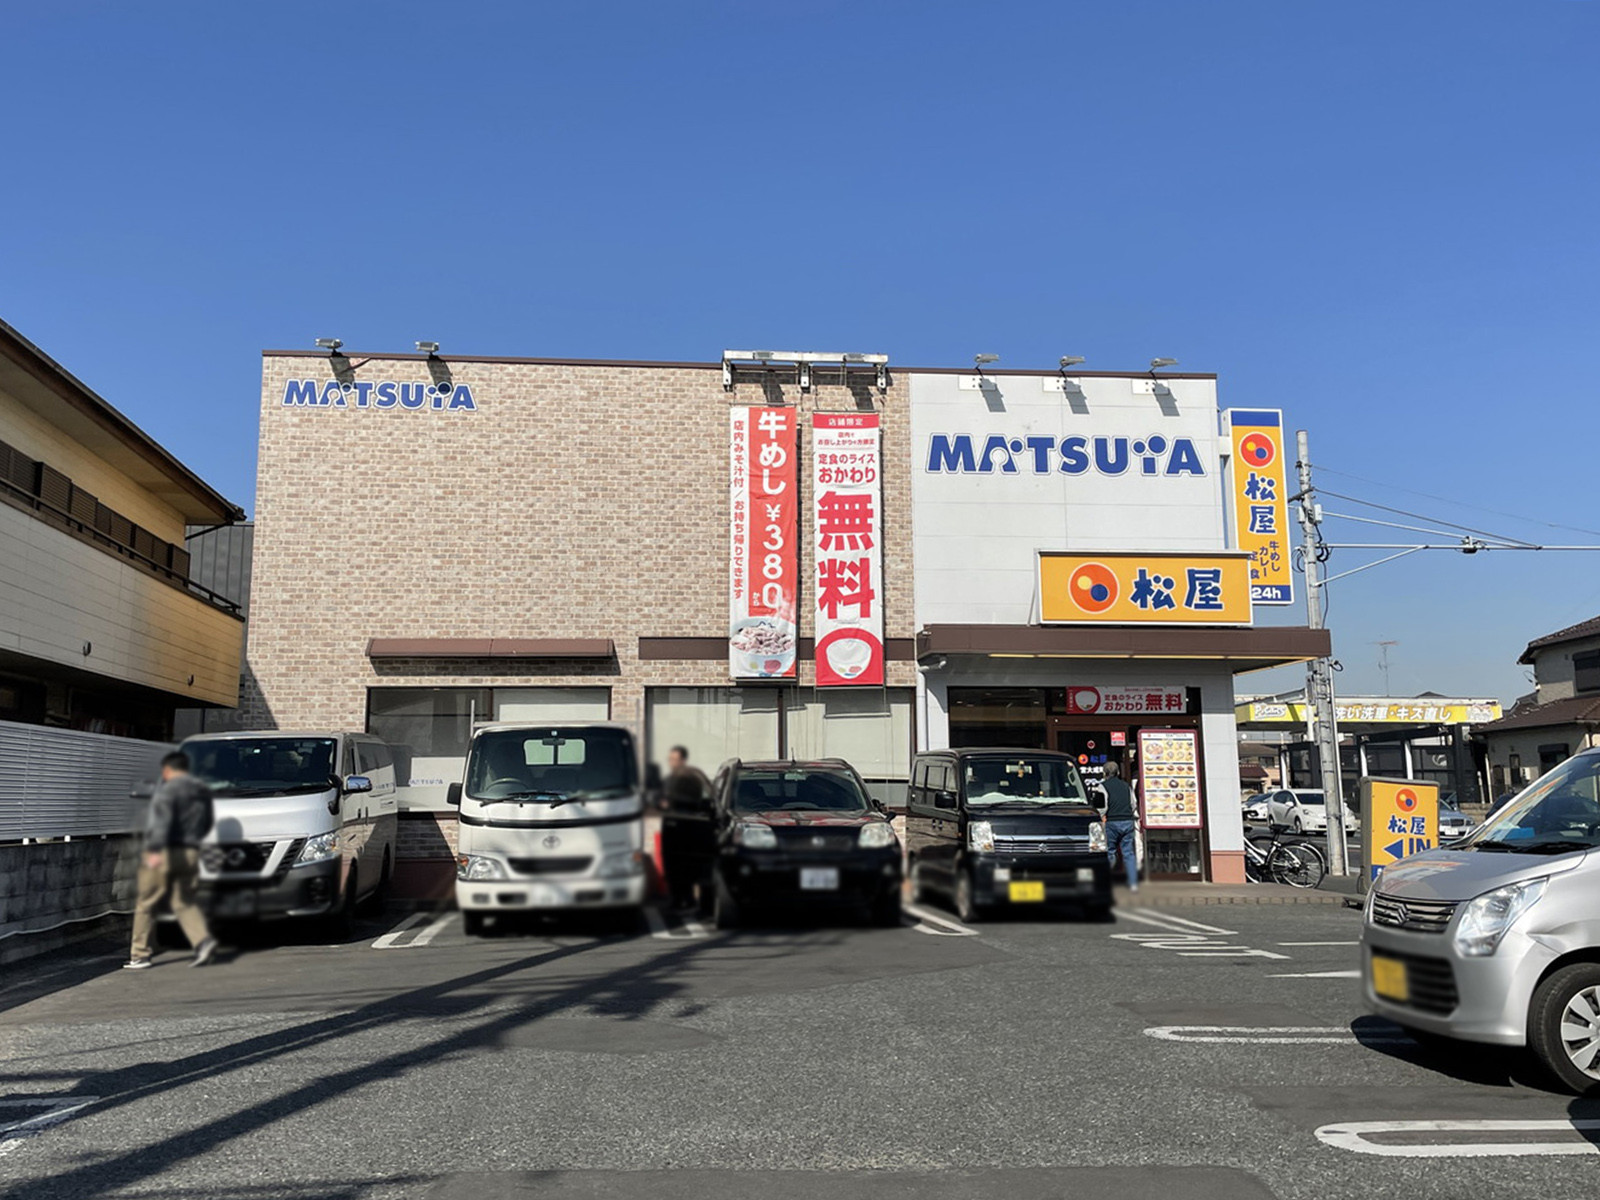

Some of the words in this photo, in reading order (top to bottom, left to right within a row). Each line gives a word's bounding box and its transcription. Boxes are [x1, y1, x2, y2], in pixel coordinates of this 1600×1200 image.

[758, 411, 787, 495] 牛めし
[818, 453, 875, 465] 定食のライス
[818, 467, 876, 483] おかわり
[1244, 473, 1276, 535] 松屋
[818, 491, 875, 619] 無料
[1259, 546, 1270, 577] カレー
[1269, 541, 1281, 572] 牛めし
[1130, 568, 1224, 610] 松屋
[1251, 587, 1281, 599] 24h
[1104, 702, 1143, 711] おかわり
[1145, 693, 1183, 711] 無料
[1388, 815, 1426, 835] 松屋
[1409, 838, 1431, 856] IN
